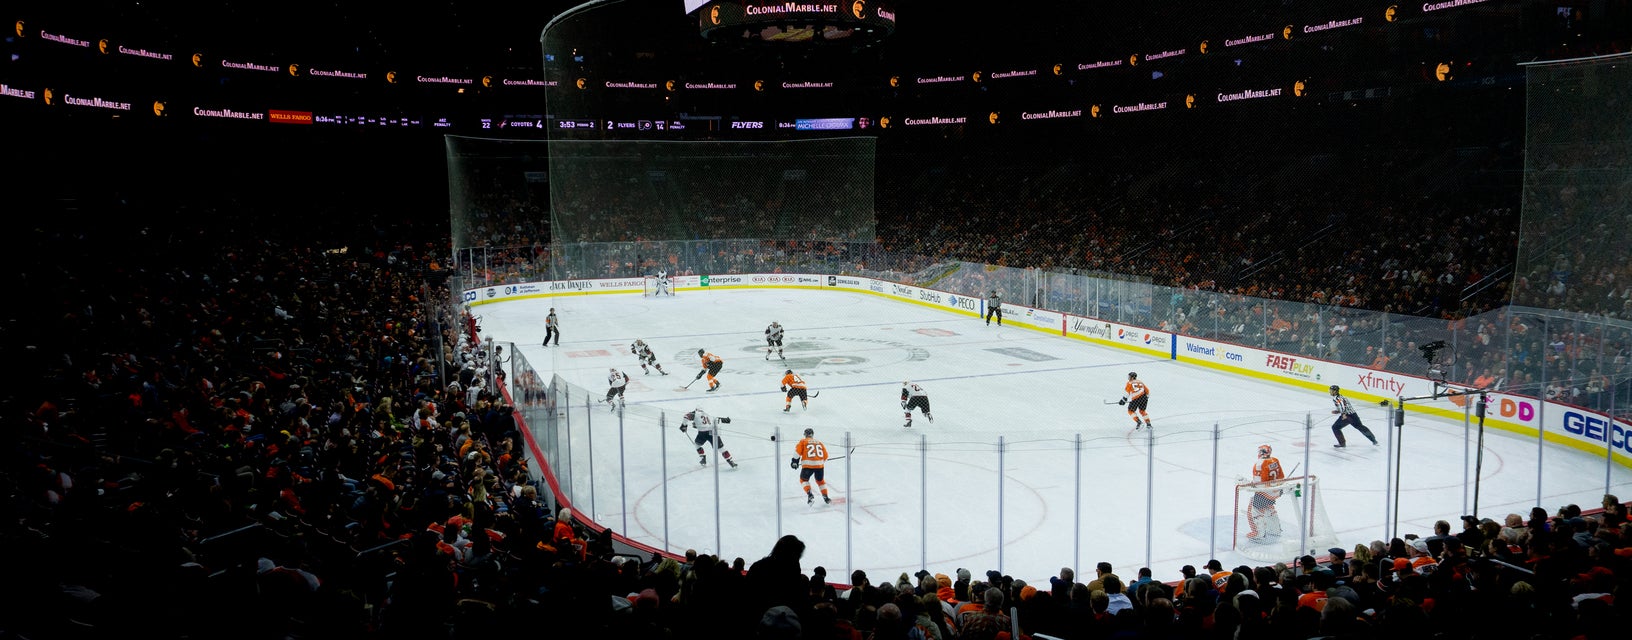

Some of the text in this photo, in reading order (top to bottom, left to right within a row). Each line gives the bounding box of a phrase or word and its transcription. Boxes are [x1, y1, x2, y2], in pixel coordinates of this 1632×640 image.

[747, 2, 837, 15] COLONIALMARBLE.NET
[1218, 89, 1281, 102] COLONIALMARBLE.NET
[65, 94, 130, 110] COLONIALMARBLE.NET
[1114, 102, 1166, 113] COLONIALMARBLE.NET
[194, 107, 263, 119] COLONIALMARBLE.NET
[1021, 110, 1082, 120] COLONIALMARBLE.NET
[536, 120, 543, 129] 4
[607, 120, 614, 130] 2
[731, 121, 764, 129] FLYERS
[904, 116, 967, 126] COLONIALMARBLE.NET
[549, 281, 566, 290] JACK
[703, 276, 742, 286] enterprise
[920, 290, 941, 303] StubHub
[958, 297, 975, 311] PECO
[1186, 342, 1215, 356] Walmart
[1358, 372, 1405, 397] xfinity
[806, 444, 824, 458] 26
